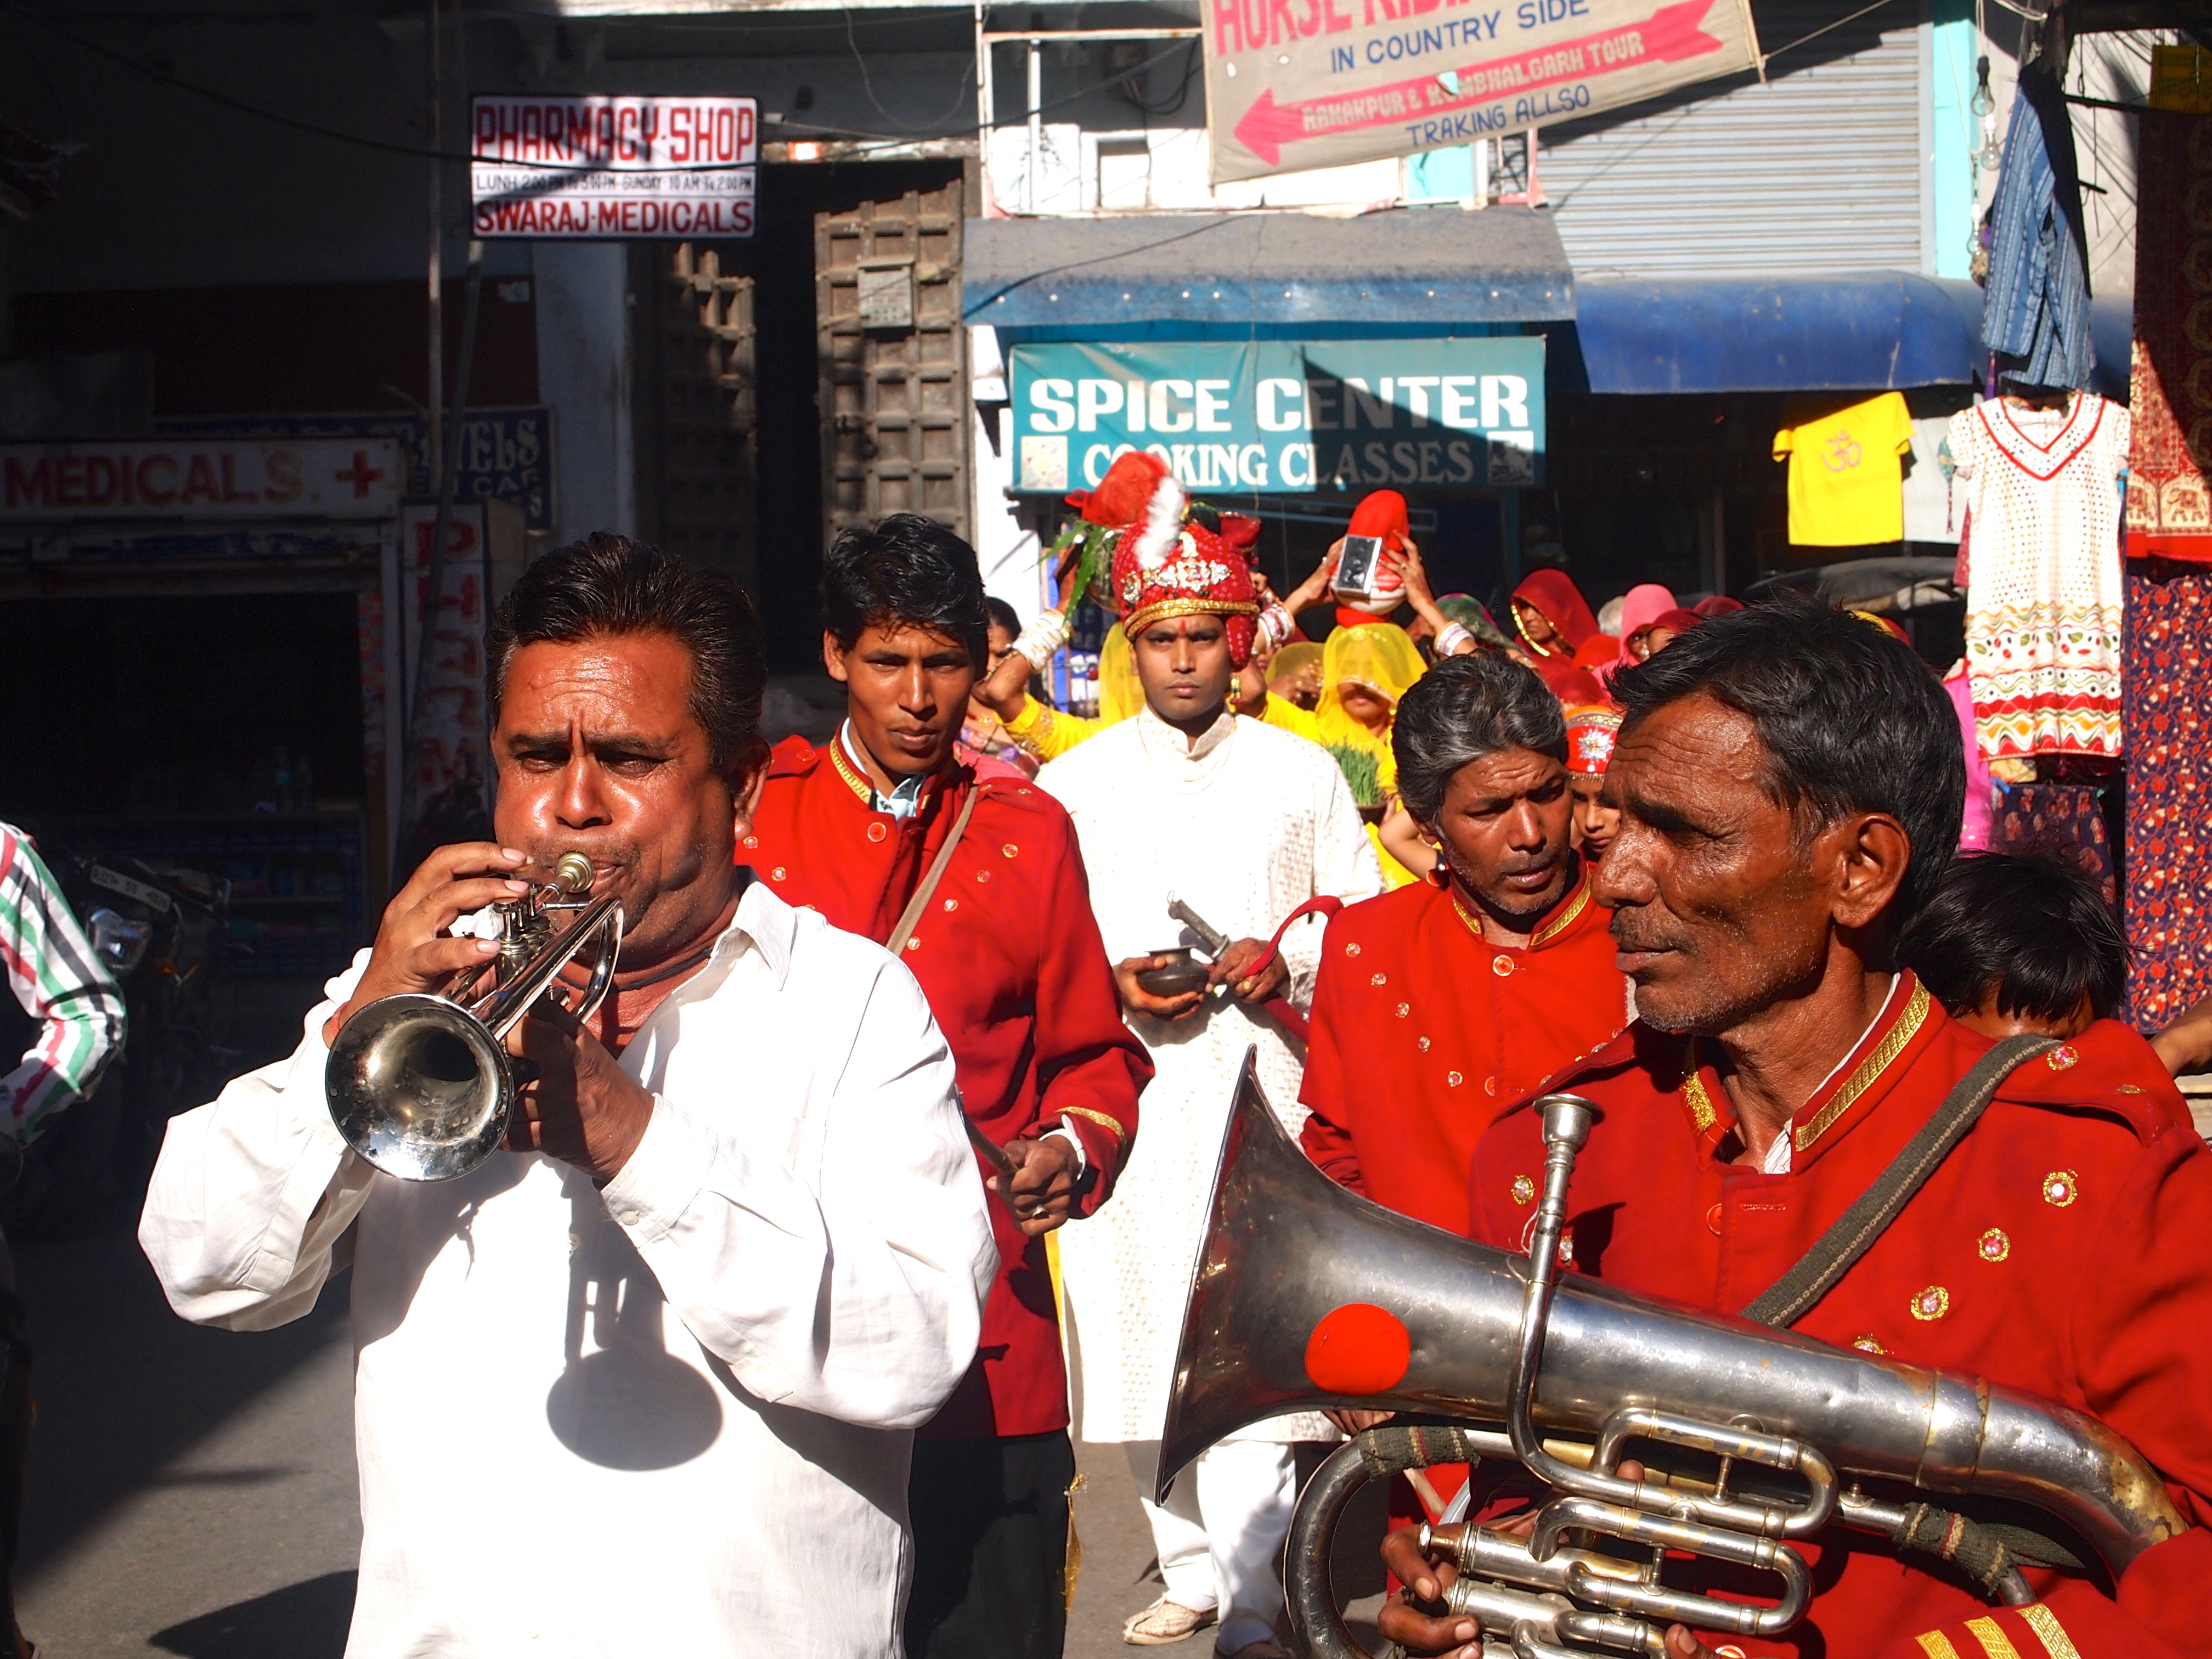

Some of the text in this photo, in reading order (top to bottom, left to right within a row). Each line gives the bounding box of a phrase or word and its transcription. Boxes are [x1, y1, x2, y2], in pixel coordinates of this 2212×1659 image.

[1331, 45, 1355, 72] IN
[1367, 10, 1502, 64] COUNTRY
[1518, 0, 1590, 29] SIDE
[1407, 88, 1423, 110] &
[1426, 47, 1585, 106] KMBHALGARH
[1588, 31, 1645, 67] TOUR
[476, 105, 753, 161] PHARMACY SHOP
[1406, 84, 1591, 147] TRAKING ALLSO
[476, 201, 752, 233] SWARAJ MEDICALS
[1030, 375, 1529, 432] SPICE CENTER
[1279, 440, 1474, 486] CLASSES
